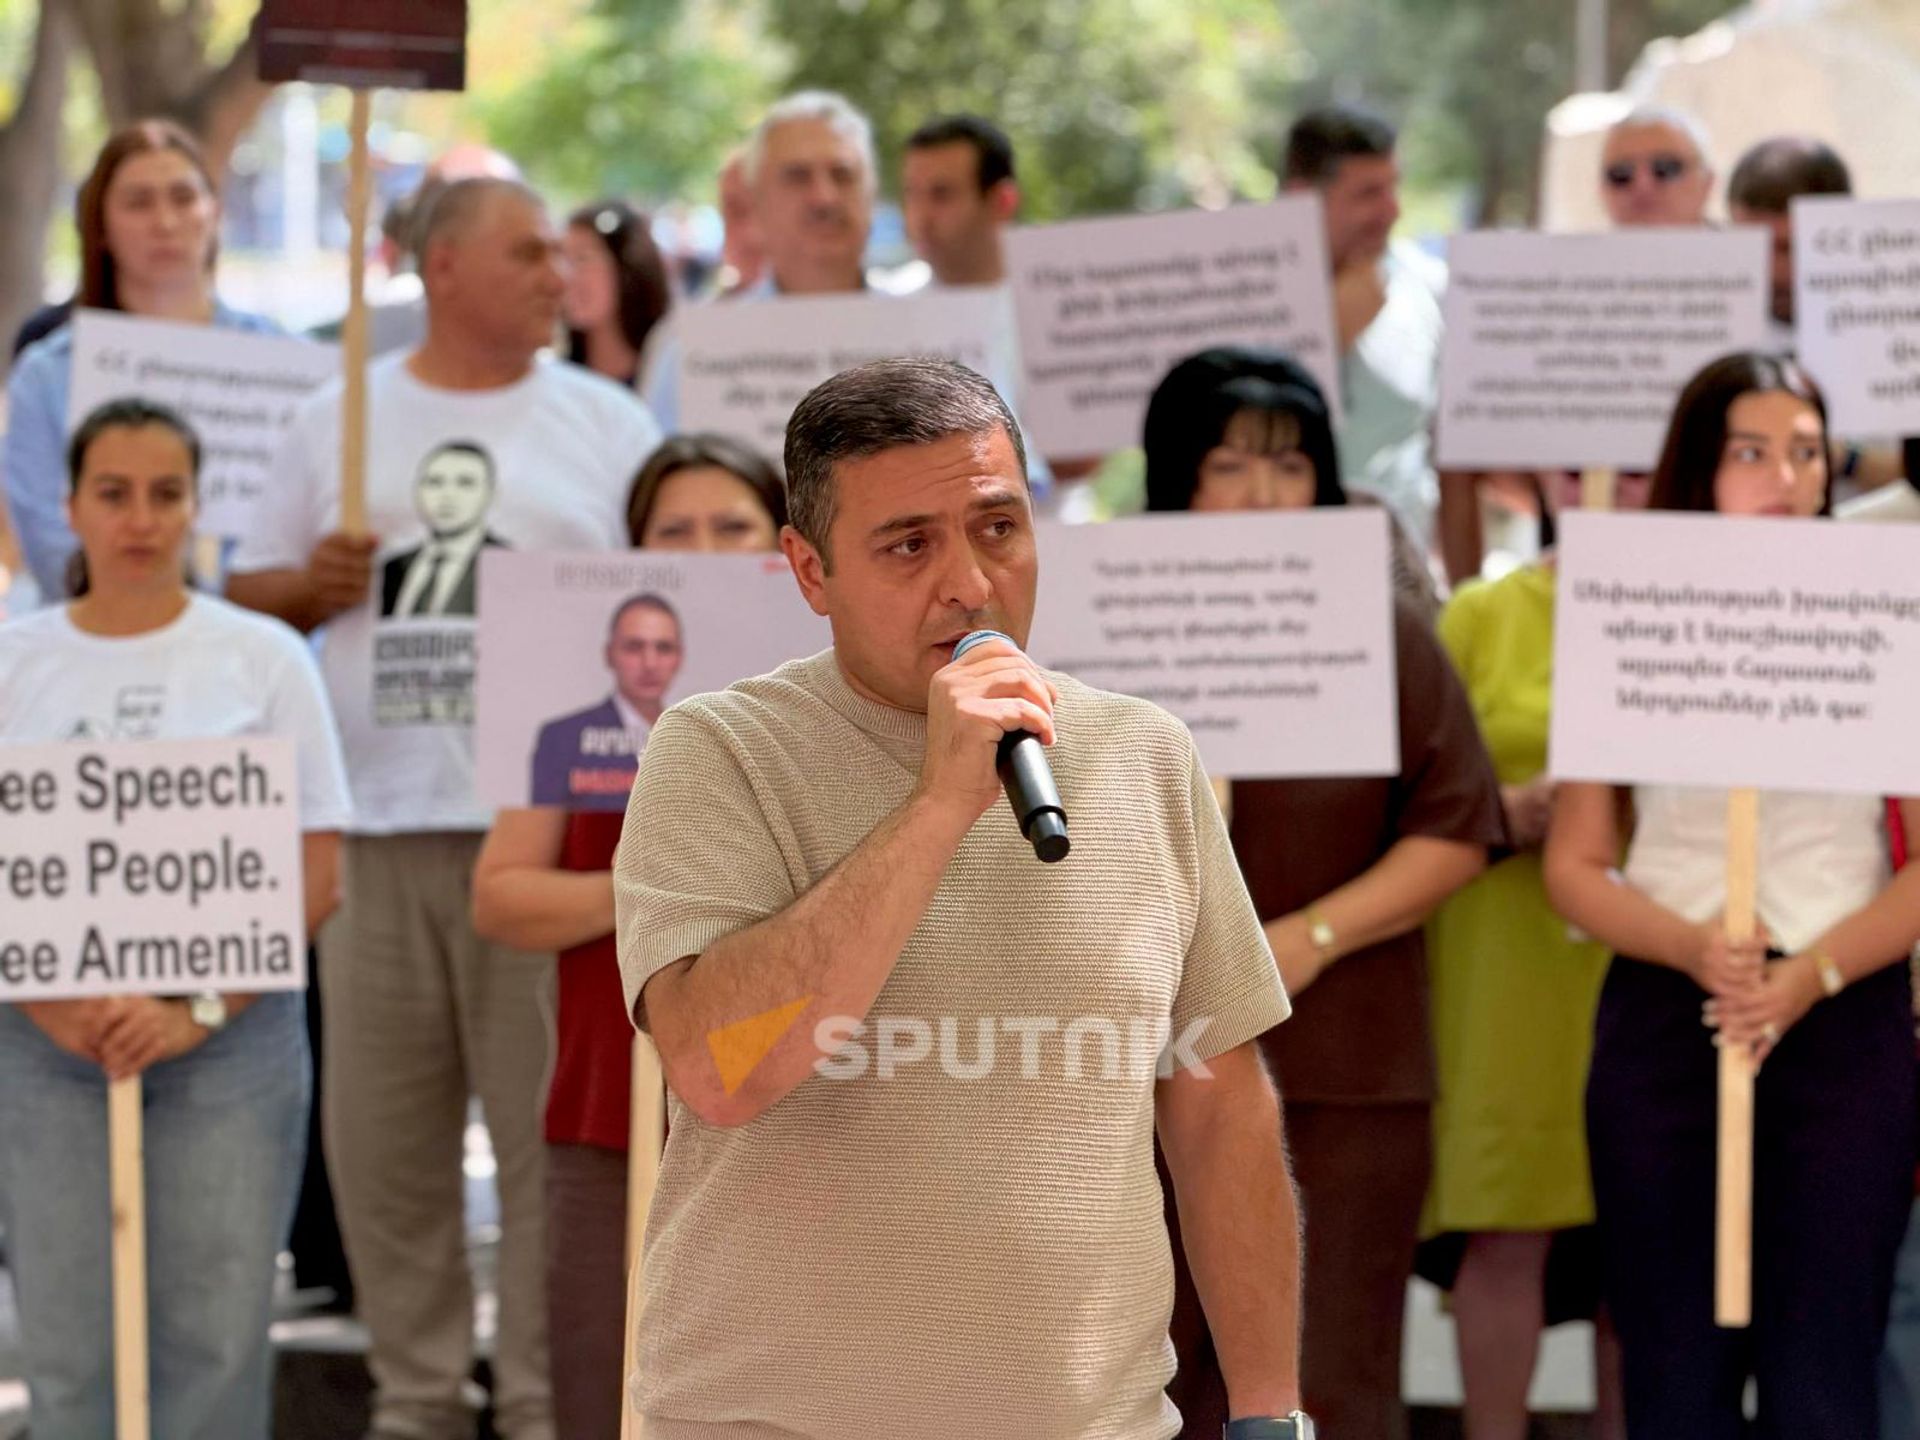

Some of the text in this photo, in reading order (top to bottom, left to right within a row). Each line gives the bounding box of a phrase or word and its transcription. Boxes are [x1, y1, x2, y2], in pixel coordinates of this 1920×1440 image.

[76, 750, 284, 826] Speech.
[87, 835, 278, 908] People.
[75, 919, 292, 983] Armenia
